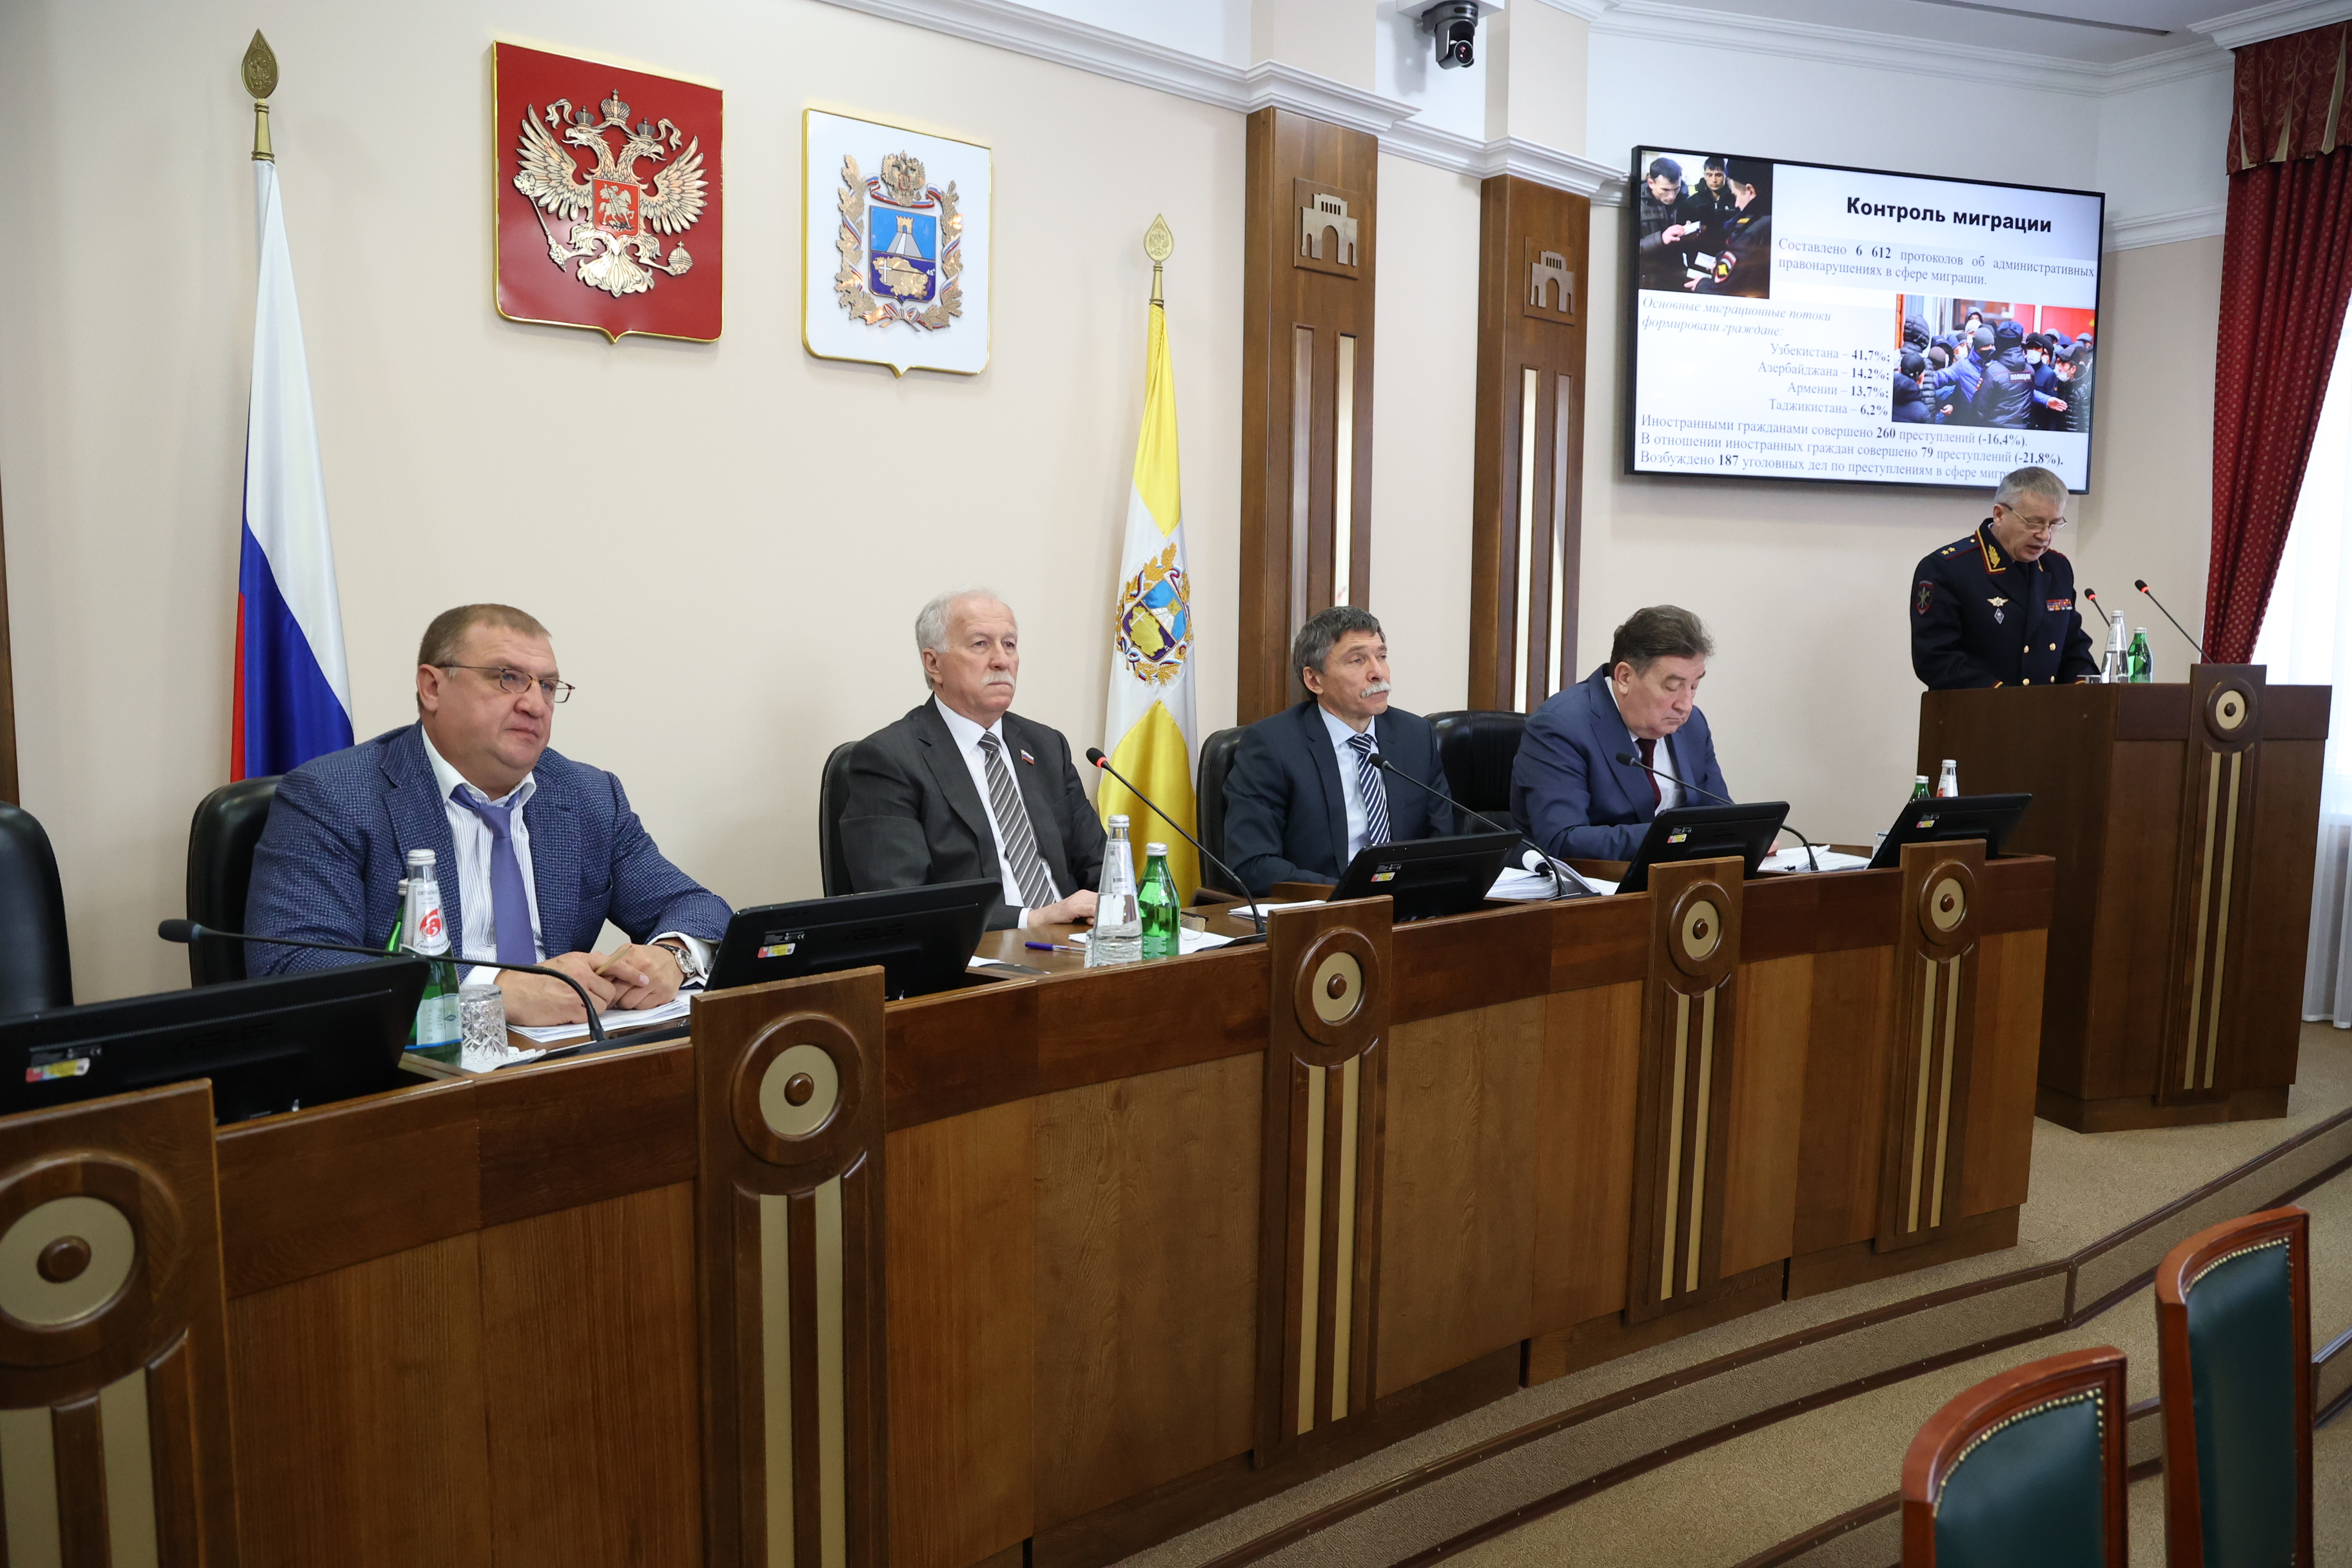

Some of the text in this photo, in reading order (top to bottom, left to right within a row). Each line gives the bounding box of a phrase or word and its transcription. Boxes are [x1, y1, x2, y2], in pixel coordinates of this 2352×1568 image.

[1847, 197, 2052, 233] Контроль миграции
[1778, 237, 2095, 278] Составлено 6 612 протоколов об административных
[1778, 257, 1987, 286] правонарушениях в сфере миграции.
[1643, 296, 1831, 322] Основные миграционные потоки
[1642, 315, 1784, 337] формировали граждане:
[1770, 343, 1839, 359] Узбекистана
[1851, 349, 1890, 363] 41,7%;
[1758, 362, 1838, 378] Азербайджана
[1851, 367, 1890, 382] 14,2%;
[1787, 382, 1838, 397] Армении
[1850, 386, 1889, 400] 13,7%;
[1769, 398, 1848, 415] Таджикистана
[1860, 404, 1888, 417] 6,2%
[1642, 414, 2028, 448] Иностранными гражданами совершено 260 преступлений (-16,4%).
[1641, 432, 2063, 467] В отношении иностранных граждан совершено 79 преступлений (-21,8%).
[1640, 450, 2010, 482] Возбуждено 187 уголовных дел по преступлениям в сфере мигр
